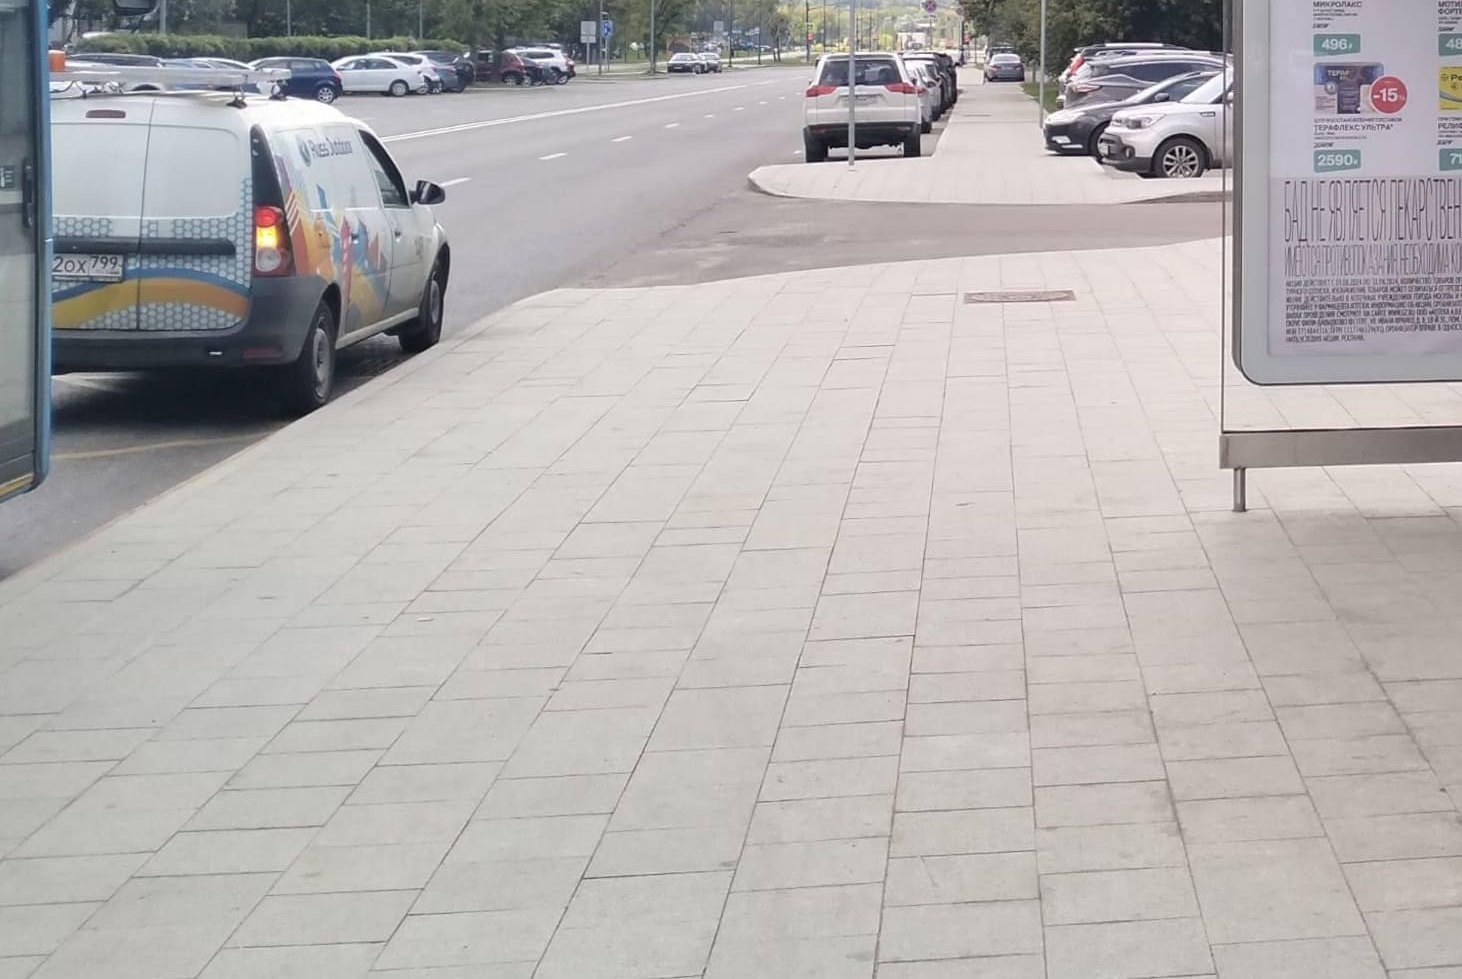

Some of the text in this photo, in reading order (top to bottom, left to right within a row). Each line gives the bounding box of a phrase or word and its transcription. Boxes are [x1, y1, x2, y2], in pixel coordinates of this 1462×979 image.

[1284, 180, 1308, 245] БАД
[1311, 180, 1327, 242] НЕ
[1329, 179, 1386, 242] ЯВЛЯЕТСЯ
